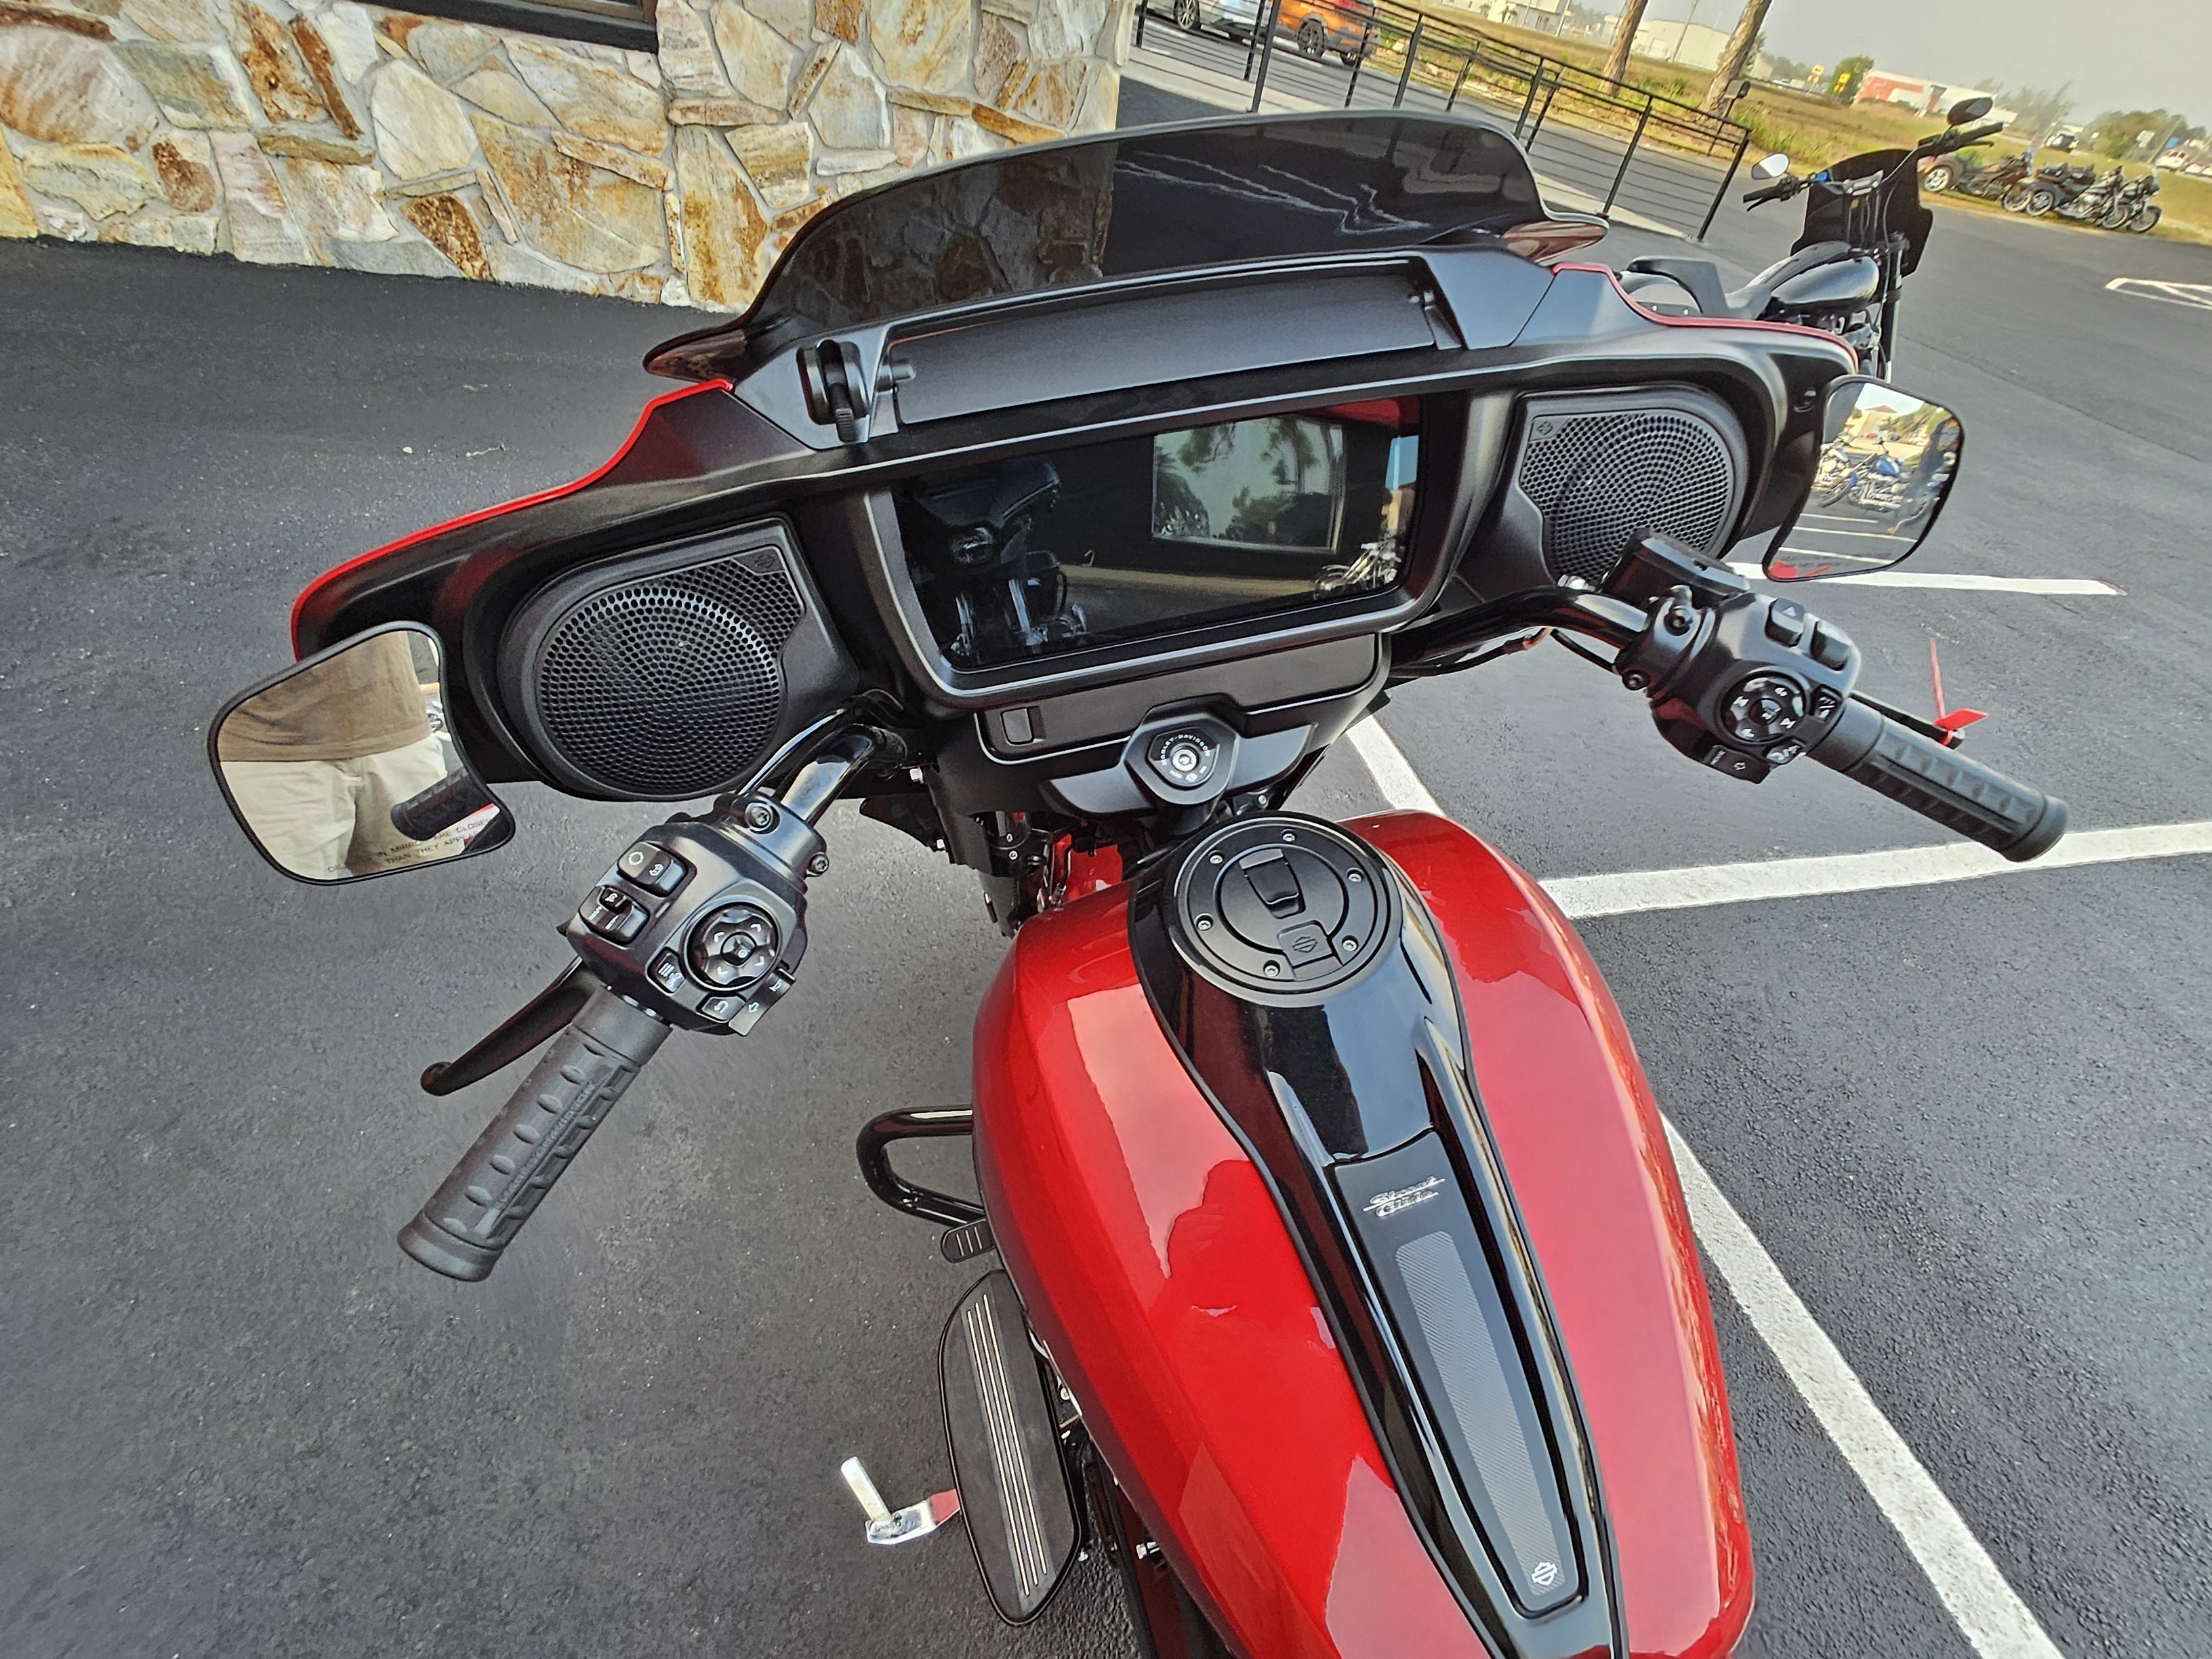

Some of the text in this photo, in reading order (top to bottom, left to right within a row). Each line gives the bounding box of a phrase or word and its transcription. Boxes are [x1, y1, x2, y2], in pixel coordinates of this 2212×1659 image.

[1160, 734, 1210, 766] HARLEY-DAVIDSON
[386, 852, 412, 865] THAN
[415, 844, 438, 854] THEY
